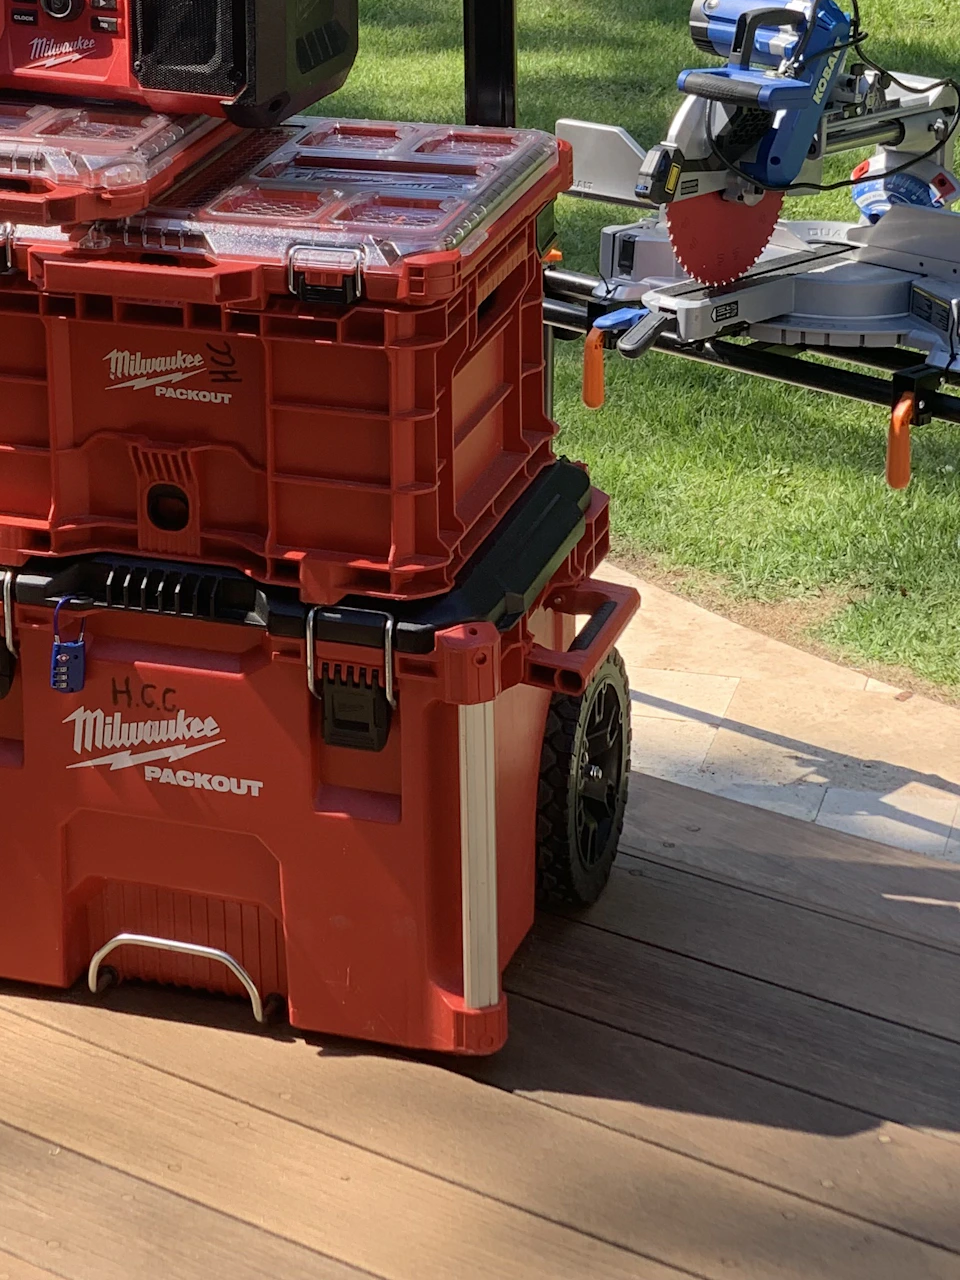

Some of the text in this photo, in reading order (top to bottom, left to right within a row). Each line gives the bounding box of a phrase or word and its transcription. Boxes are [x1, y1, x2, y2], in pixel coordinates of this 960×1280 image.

[28, 36, 96, 60] Milwaukee
[102, 349, 204, 380] Milwaukee
[155, 386, 232, 404] PACKOUT
[62, 706, 220, 754] Milwaukee
[145, 766, 263, 796] PACKOUT
